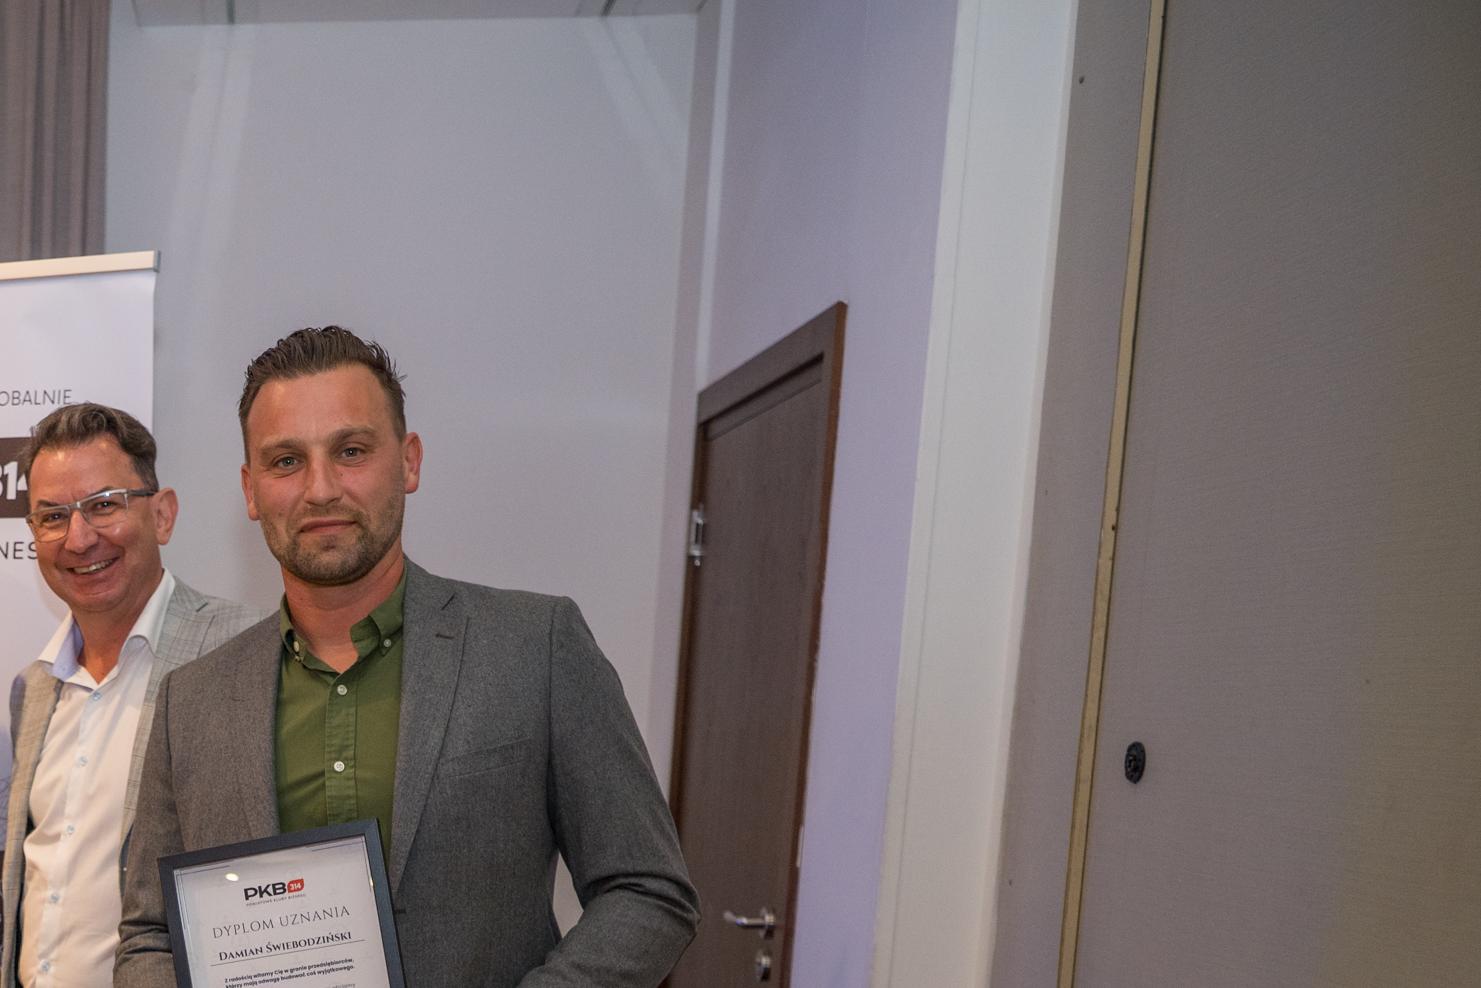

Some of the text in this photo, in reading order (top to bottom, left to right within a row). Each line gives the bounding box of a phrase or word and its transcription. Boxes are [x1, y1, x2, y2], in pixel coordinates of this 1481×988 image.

[244, 881, 302, 901] PKB 314
[213, 906, 350, 939] DYPLOM UZNANIA
[219, 930, 352, 961] DAMIAN ŚWIEBODZIŃSKI
